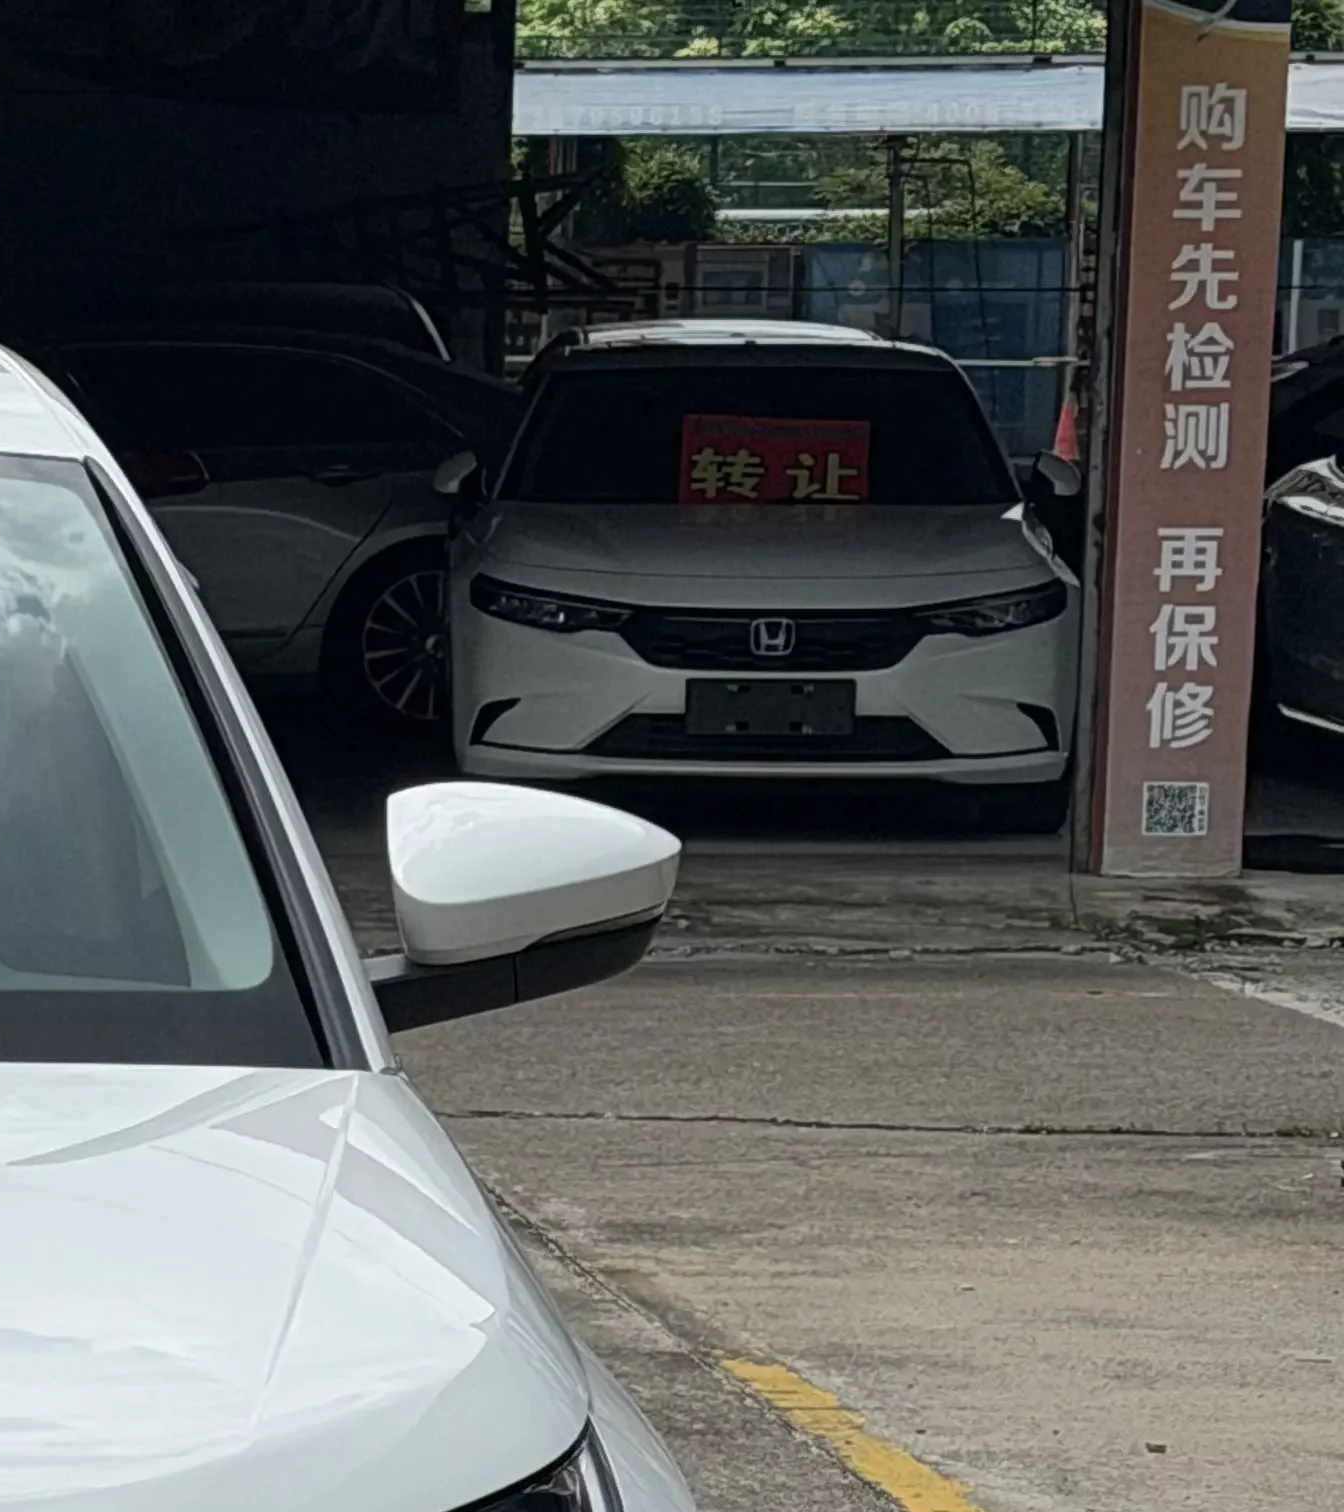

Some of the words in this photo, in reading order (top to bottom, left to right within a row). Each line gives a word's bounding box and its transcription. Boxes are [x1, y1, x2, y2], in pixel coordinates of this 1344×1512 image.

[1159, 82, 1247, 471] 购车先检测
[690, 447, 861, 500] 转让
[1146, 527, 1224, 750] 再保修
